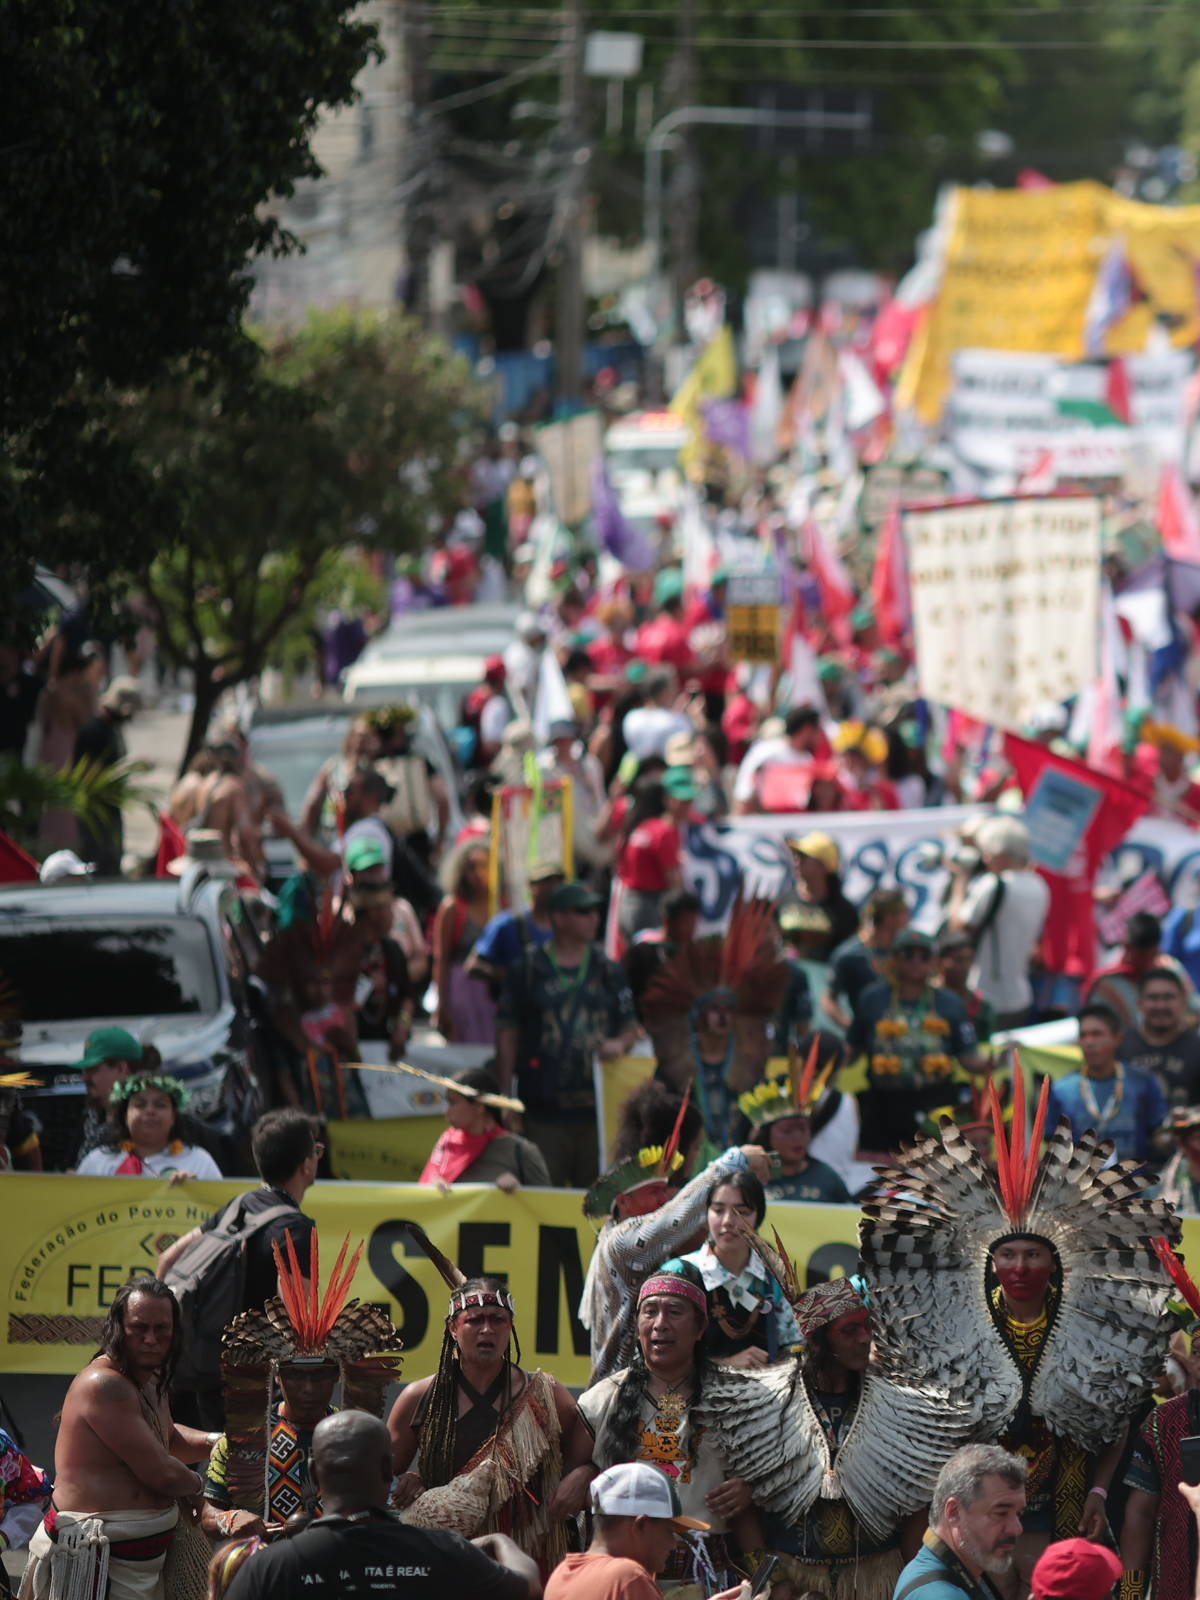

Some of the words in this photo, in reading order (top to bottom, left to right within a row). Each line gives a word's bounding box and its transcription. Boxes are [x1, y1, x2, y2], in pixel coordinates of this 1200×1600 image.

[15, 1219, 88, 1302] Federação
[96, 1210, 119, 1226] do
[129, 1206, 176, 1220] Povo
[385, 1564, 394, 1577] É
